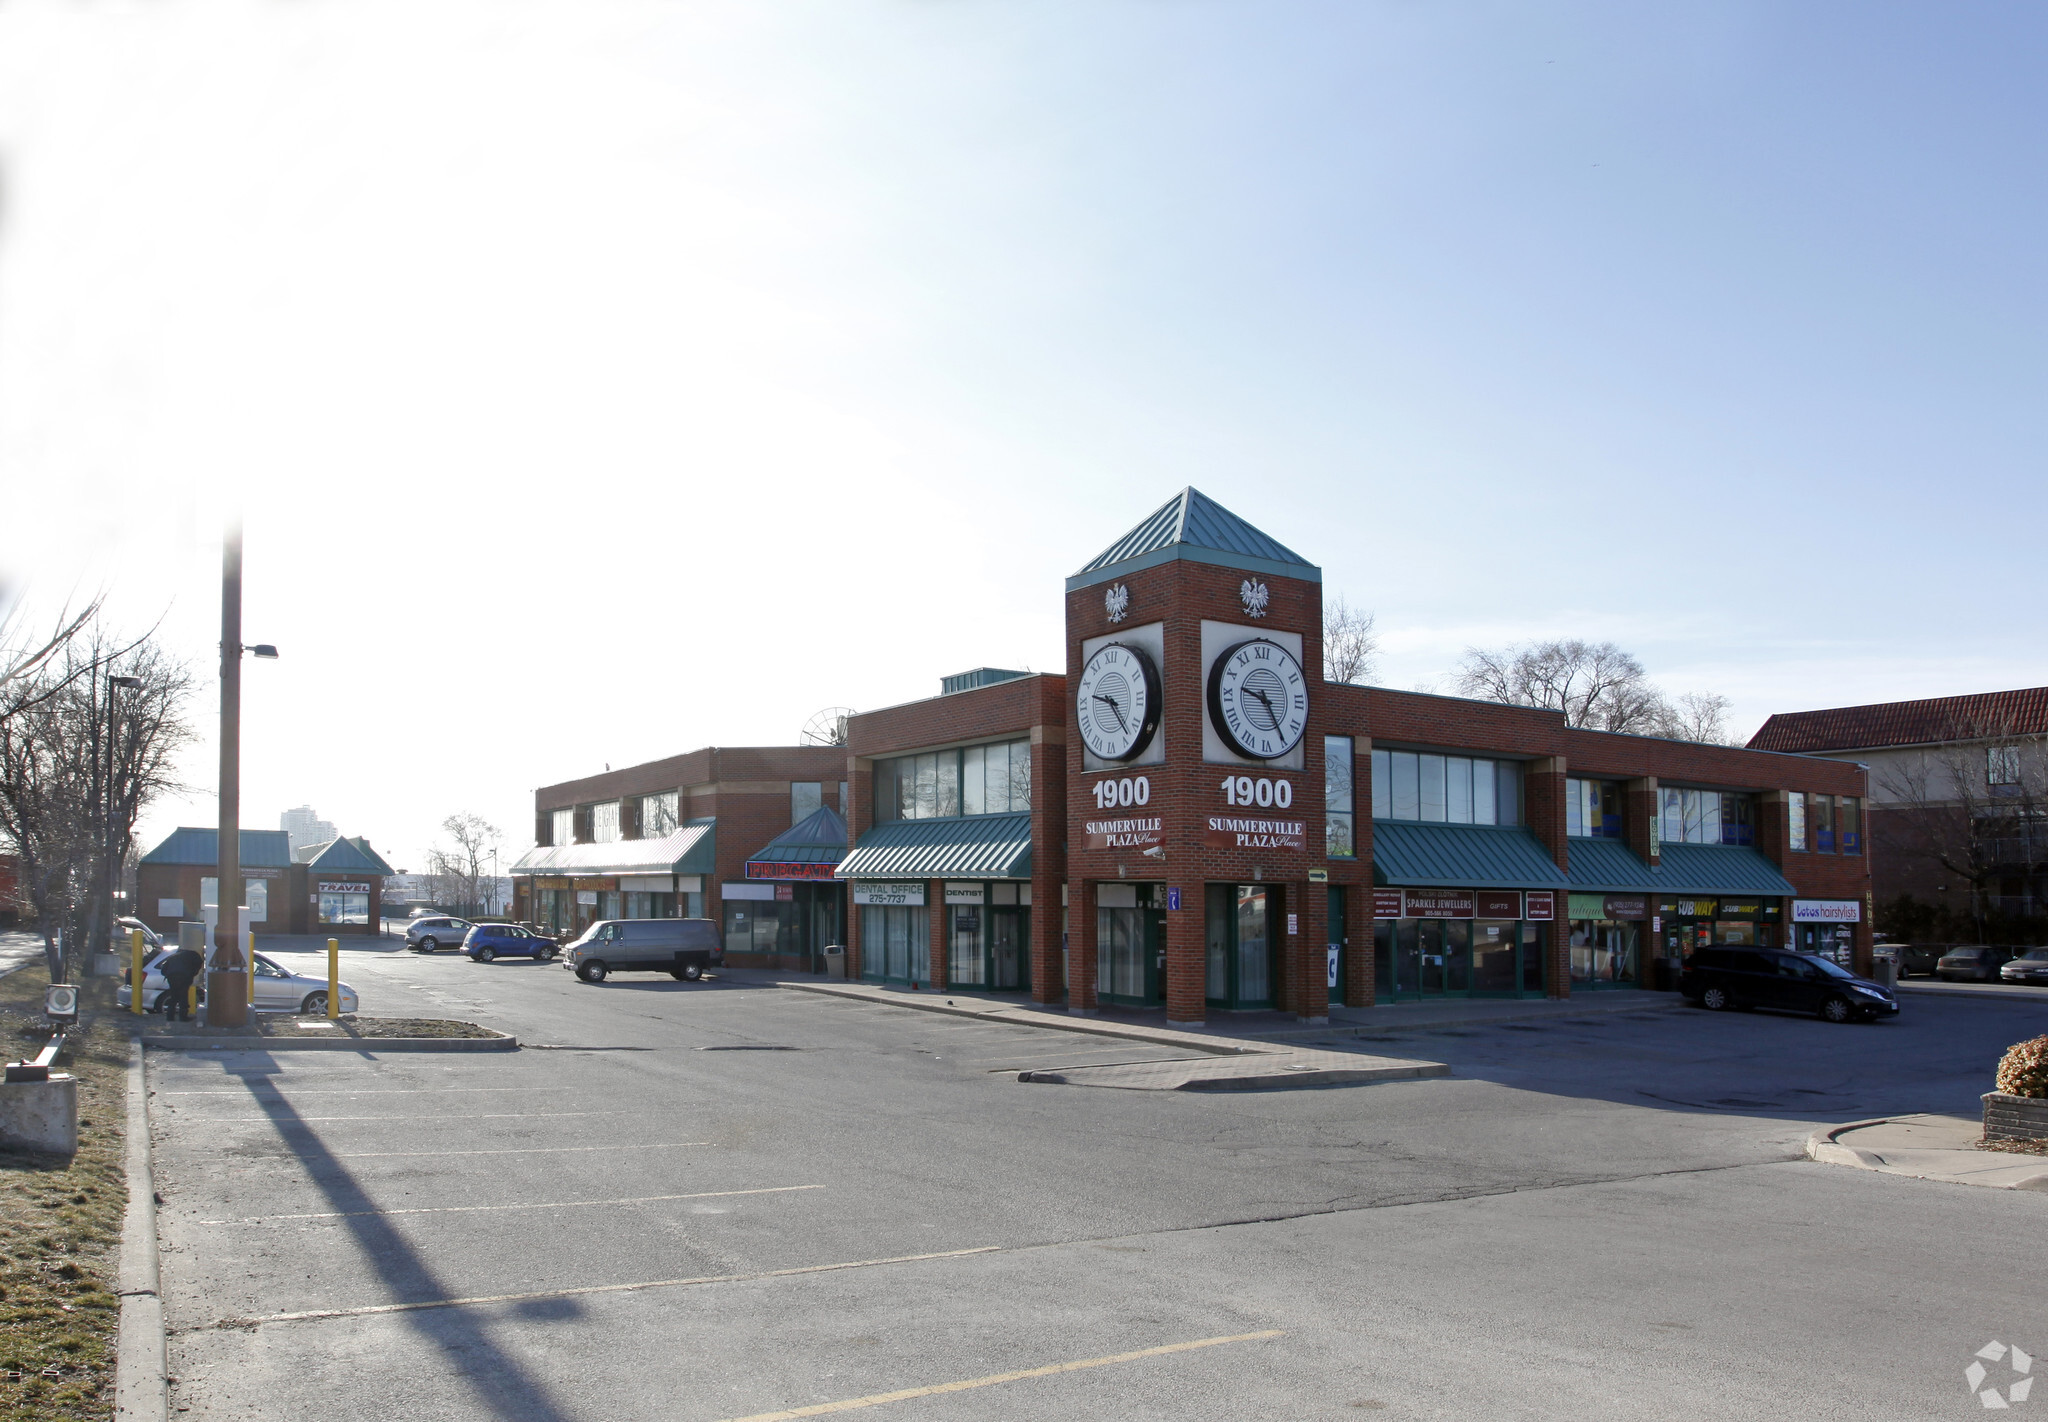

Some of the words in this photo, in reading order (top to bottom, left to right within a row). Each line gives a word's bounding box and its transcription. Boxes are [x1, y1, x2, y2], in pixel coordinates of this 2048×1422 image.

[1104, 651, 1117, 664] XII
[1236, 651, 1250, 667] XI
[1255, 647, 1270, 660] XII
[1090, 660, 1101, 675] XI
[1124, 656, 1129, 667] I
[1279, 656, 1285, 667] I
[1132, 669, 1140, 682] II
[1227, 668, 1237, 680] X
[1289, 672, 1299, 684] II
[1083, 679, 1091, 689] X
[1224, 688, 1233, 702] IX
[1080, 698, 1087, 710] IX
[1295, 695, 1304, 710] III
[1132, 717, 1140, 733] IV
[1290, 719, 1300, 735] IV
[1107, 742, 1115, 754] VI
[1262, 740, 1272, 752] VI
[1093, 776, 1150, 808] 1900
[1221, 776, 1292, 808] 1900
[1086, 818, 1161, 834] SUMMERVILLE
[1209, 817, 1302, 835] SUMMERVILLE
[1106, 834, 1139, 846] PLAZA
[1137, 832, 1160, 843] Place
[1236, 834, 1276, 848] PLAZA
[1275, 835, 1301, 846] Place
[855, 885, 887, 894] DENTAL
[891, 885, 922, 894] OFFICE
[869, 894, 906, 903] 275-7737
[1407, 899, 1435, 908] SPARKLE
[1437, 899, 1471, 909] JEWELLERS
[1678, 901, 1717, 916] SUBWAY
[1722, 905, 1759, 913] SUBWAY
[1797, 904, 1819, 917] Lotus
[1820, 904, 1856, 919] hairstylists
